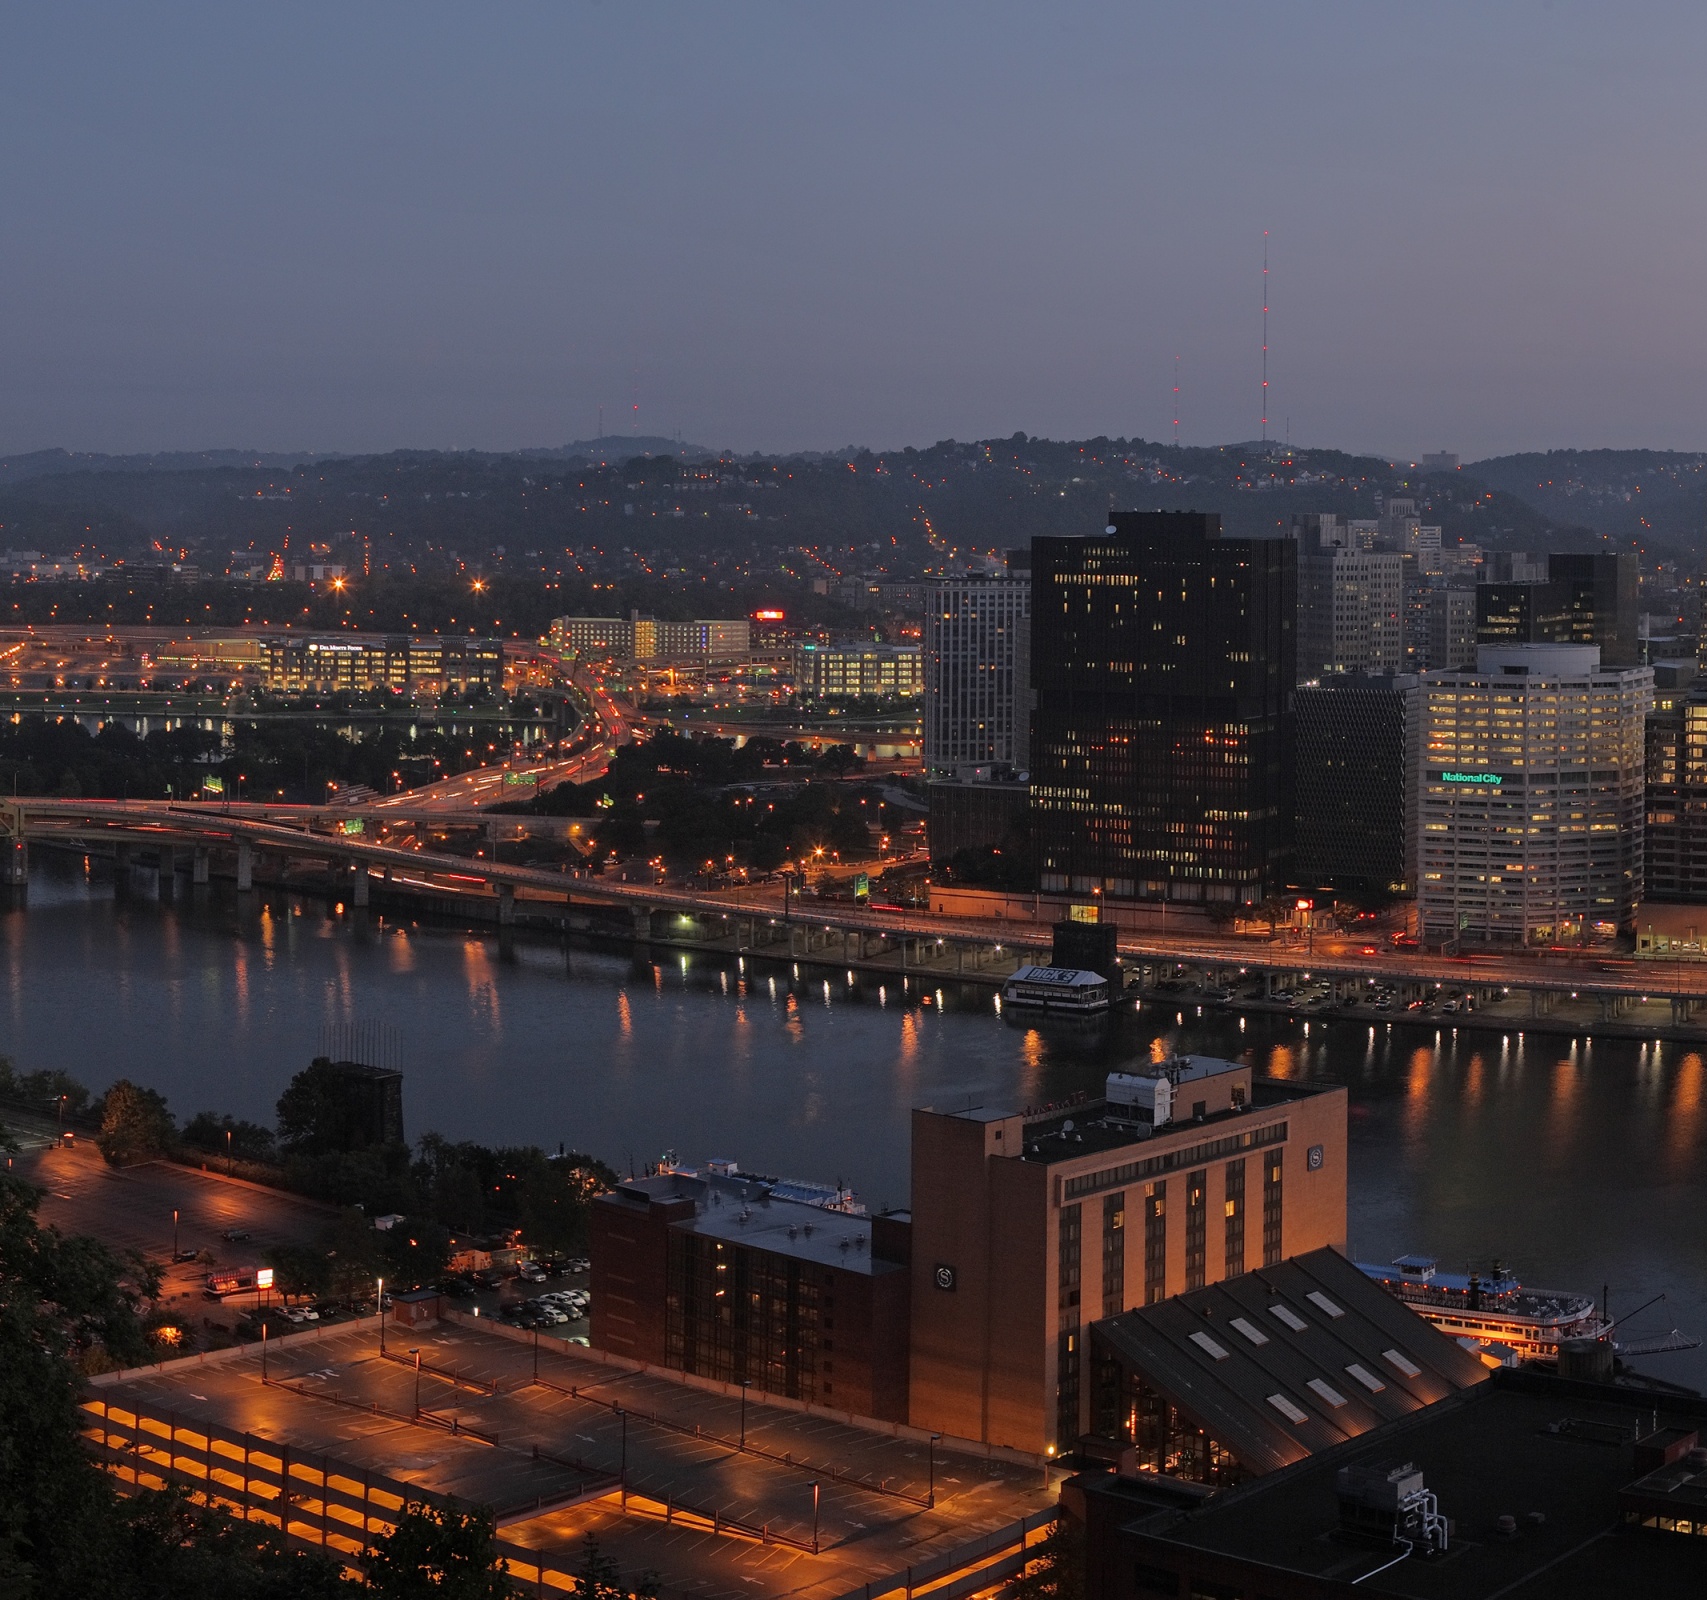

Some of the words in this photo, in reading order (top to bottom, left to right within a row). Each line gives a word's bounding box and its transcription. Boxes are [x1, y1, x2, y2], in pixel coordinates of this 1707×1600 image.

[1442, 772, 1482, 783] National
[1483, 774, 1503, 785] City
[1029, 968, 1076, 981] DICK'S
